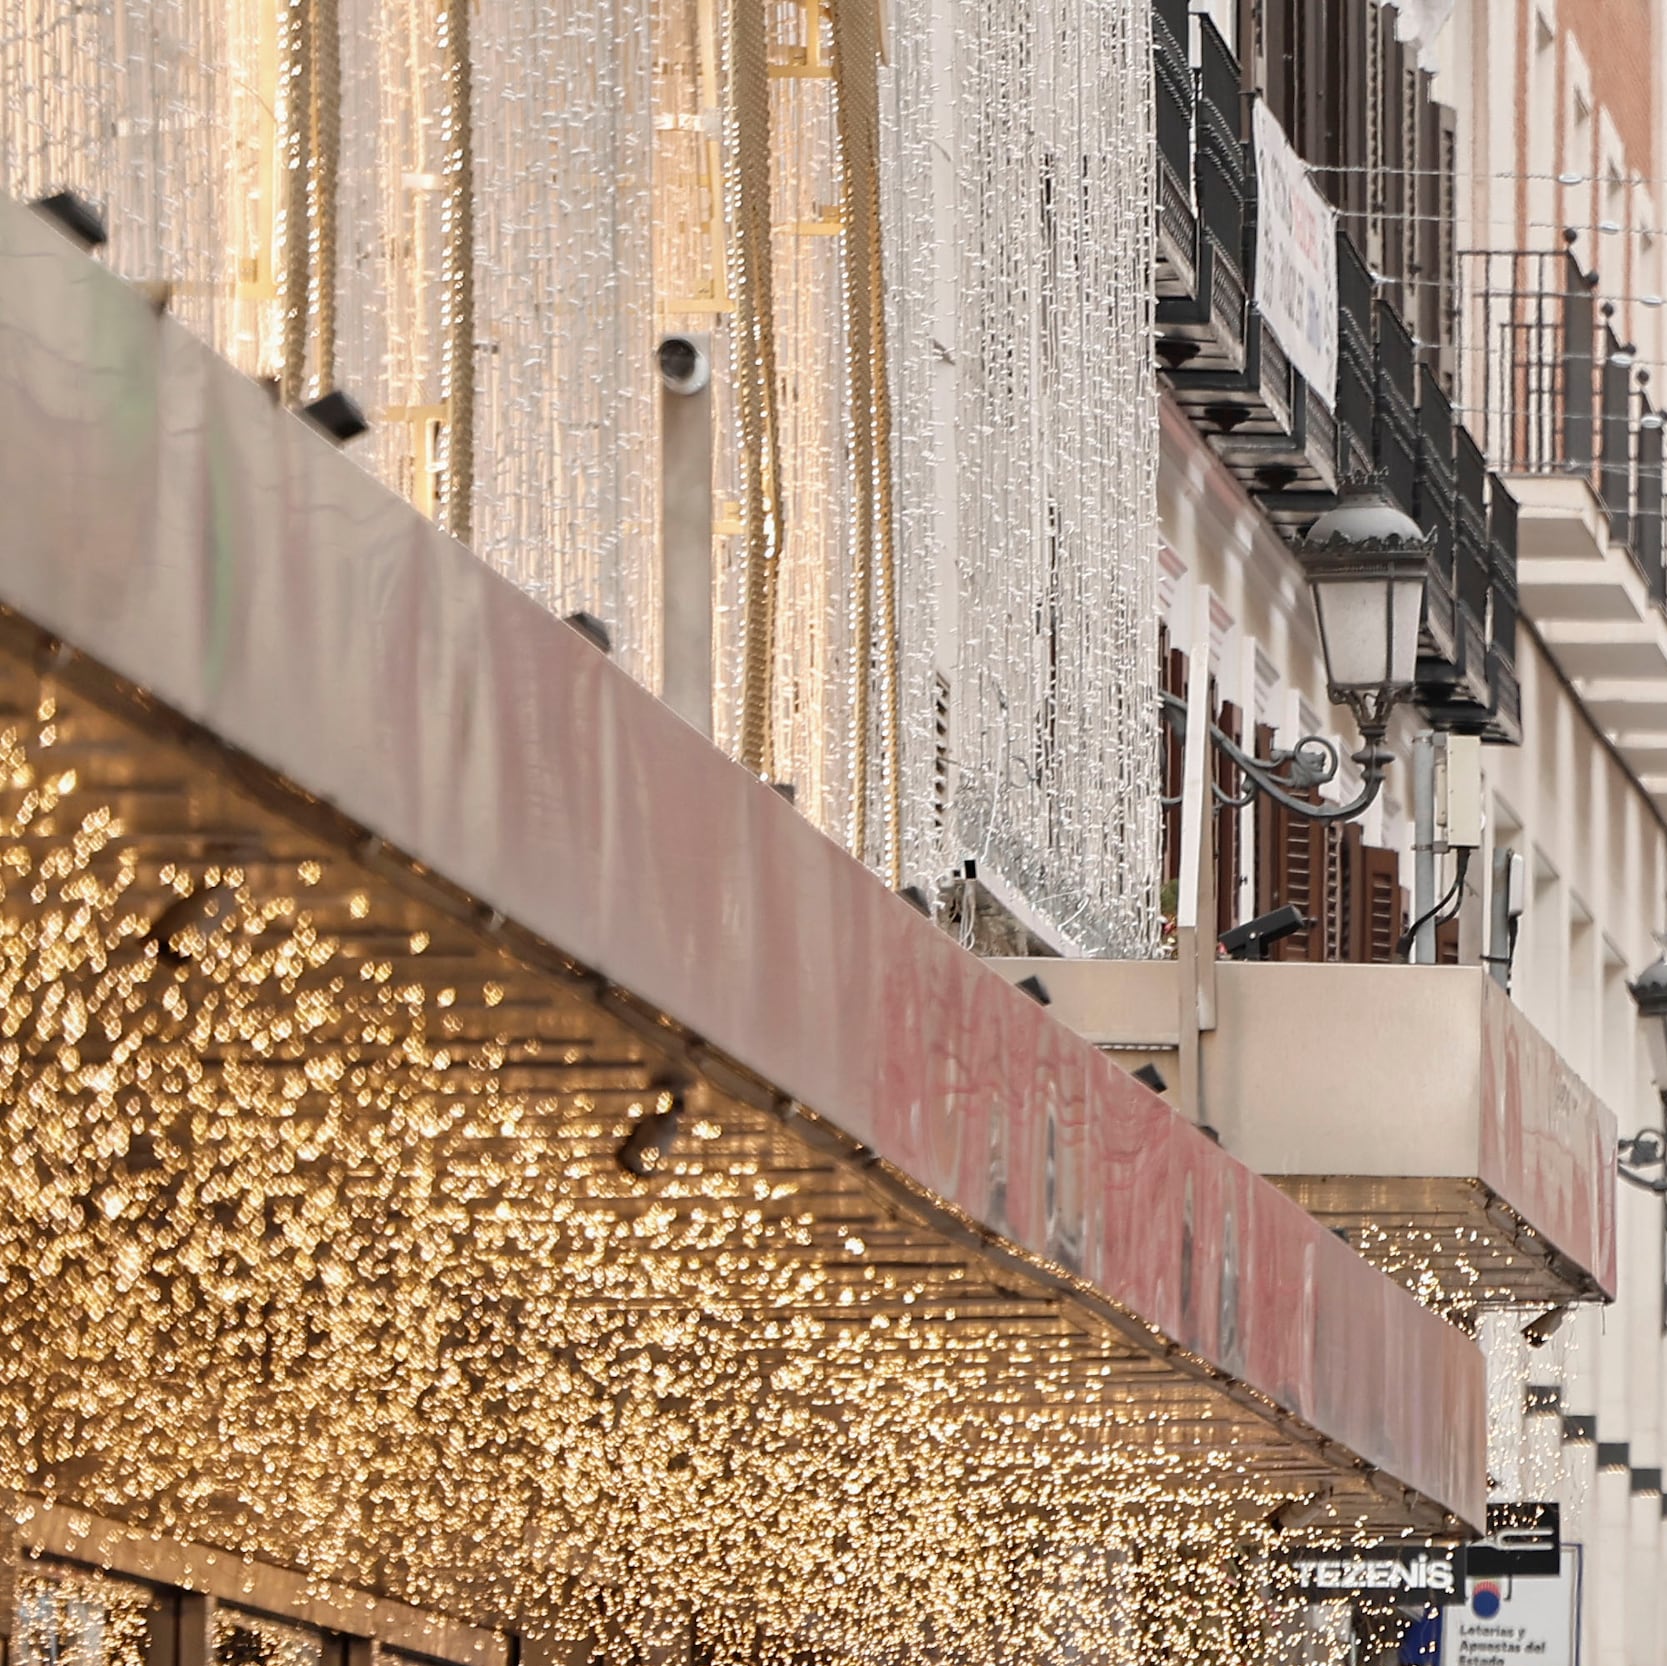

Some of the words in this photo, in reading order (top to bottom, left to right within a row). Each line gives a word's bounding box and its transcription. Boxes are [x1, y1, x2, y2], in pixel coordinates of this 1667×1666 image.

[1459, 1640, 1520, 1655] Apuestas
[1524, 1641, 1545, 1654] del
[1459, 1655, 1504, 1666] Estado
